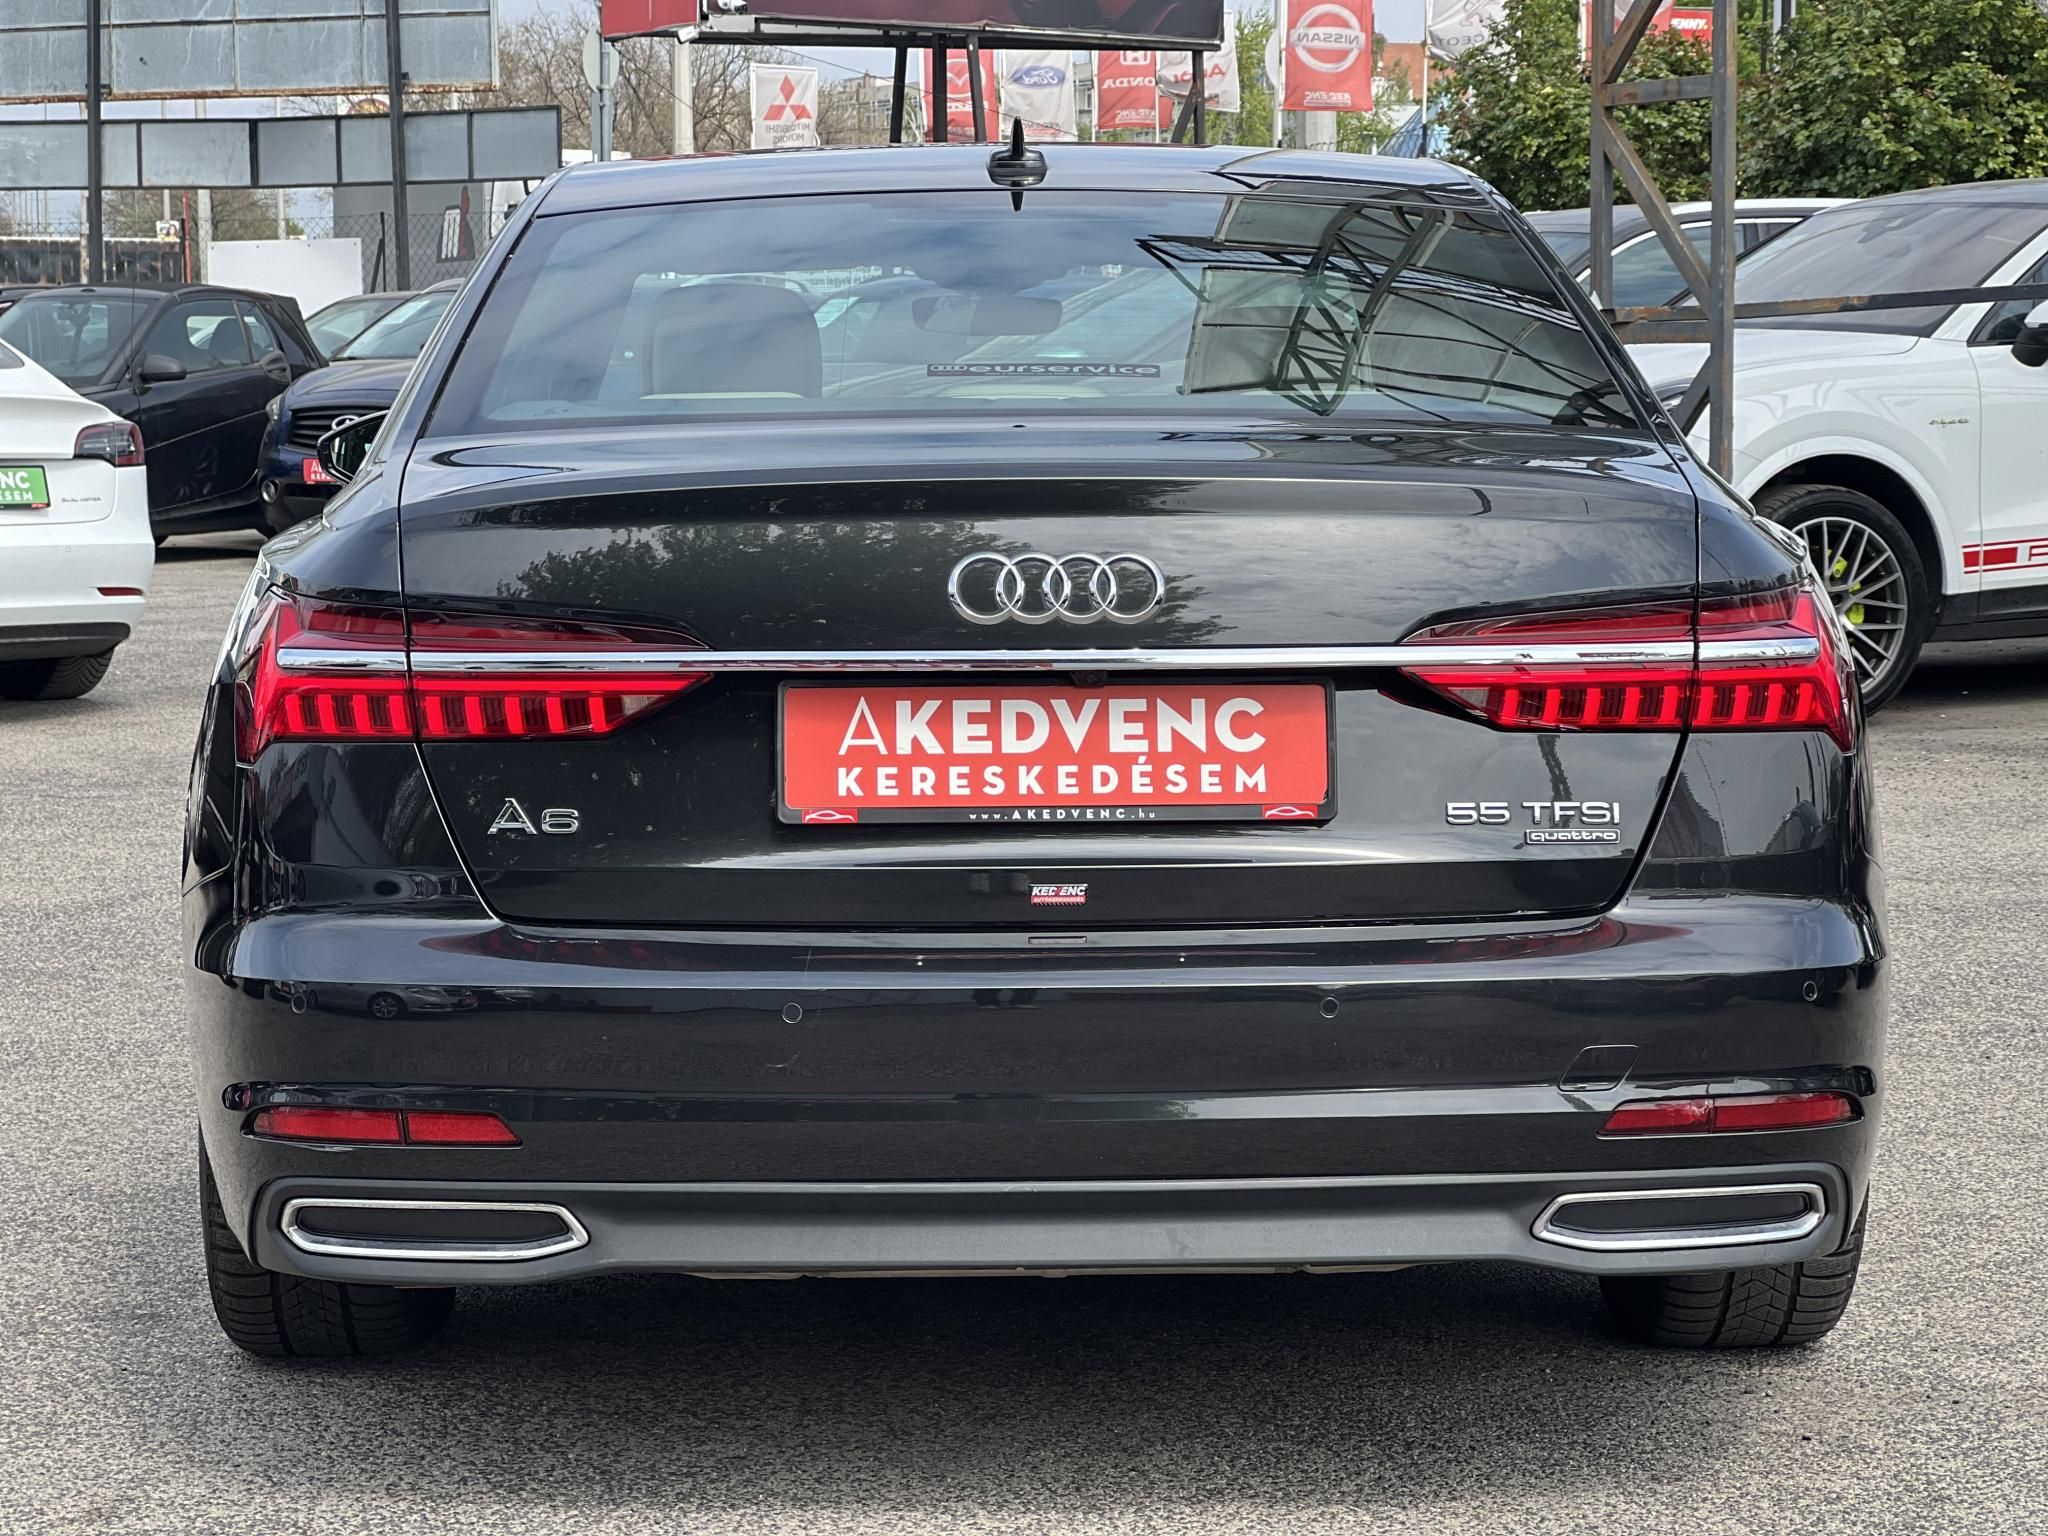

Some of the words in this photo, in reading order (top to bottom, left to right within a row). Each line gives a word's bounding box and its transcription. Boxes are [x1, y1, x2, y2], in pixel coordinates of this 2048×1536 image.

[969, 364, 1158, 375] eurservice
[838, 756, 1267, 797] KERESKEDÉSEM
[487, 798, 580, 835] A6
[969, 807, 1156, 821] www.AKEDVENC.hu
[1446, 801, 1510, 825] 55
[1521, 801, 1621, 825] TFSI
[1531, 831, 1617, 843] quattro
